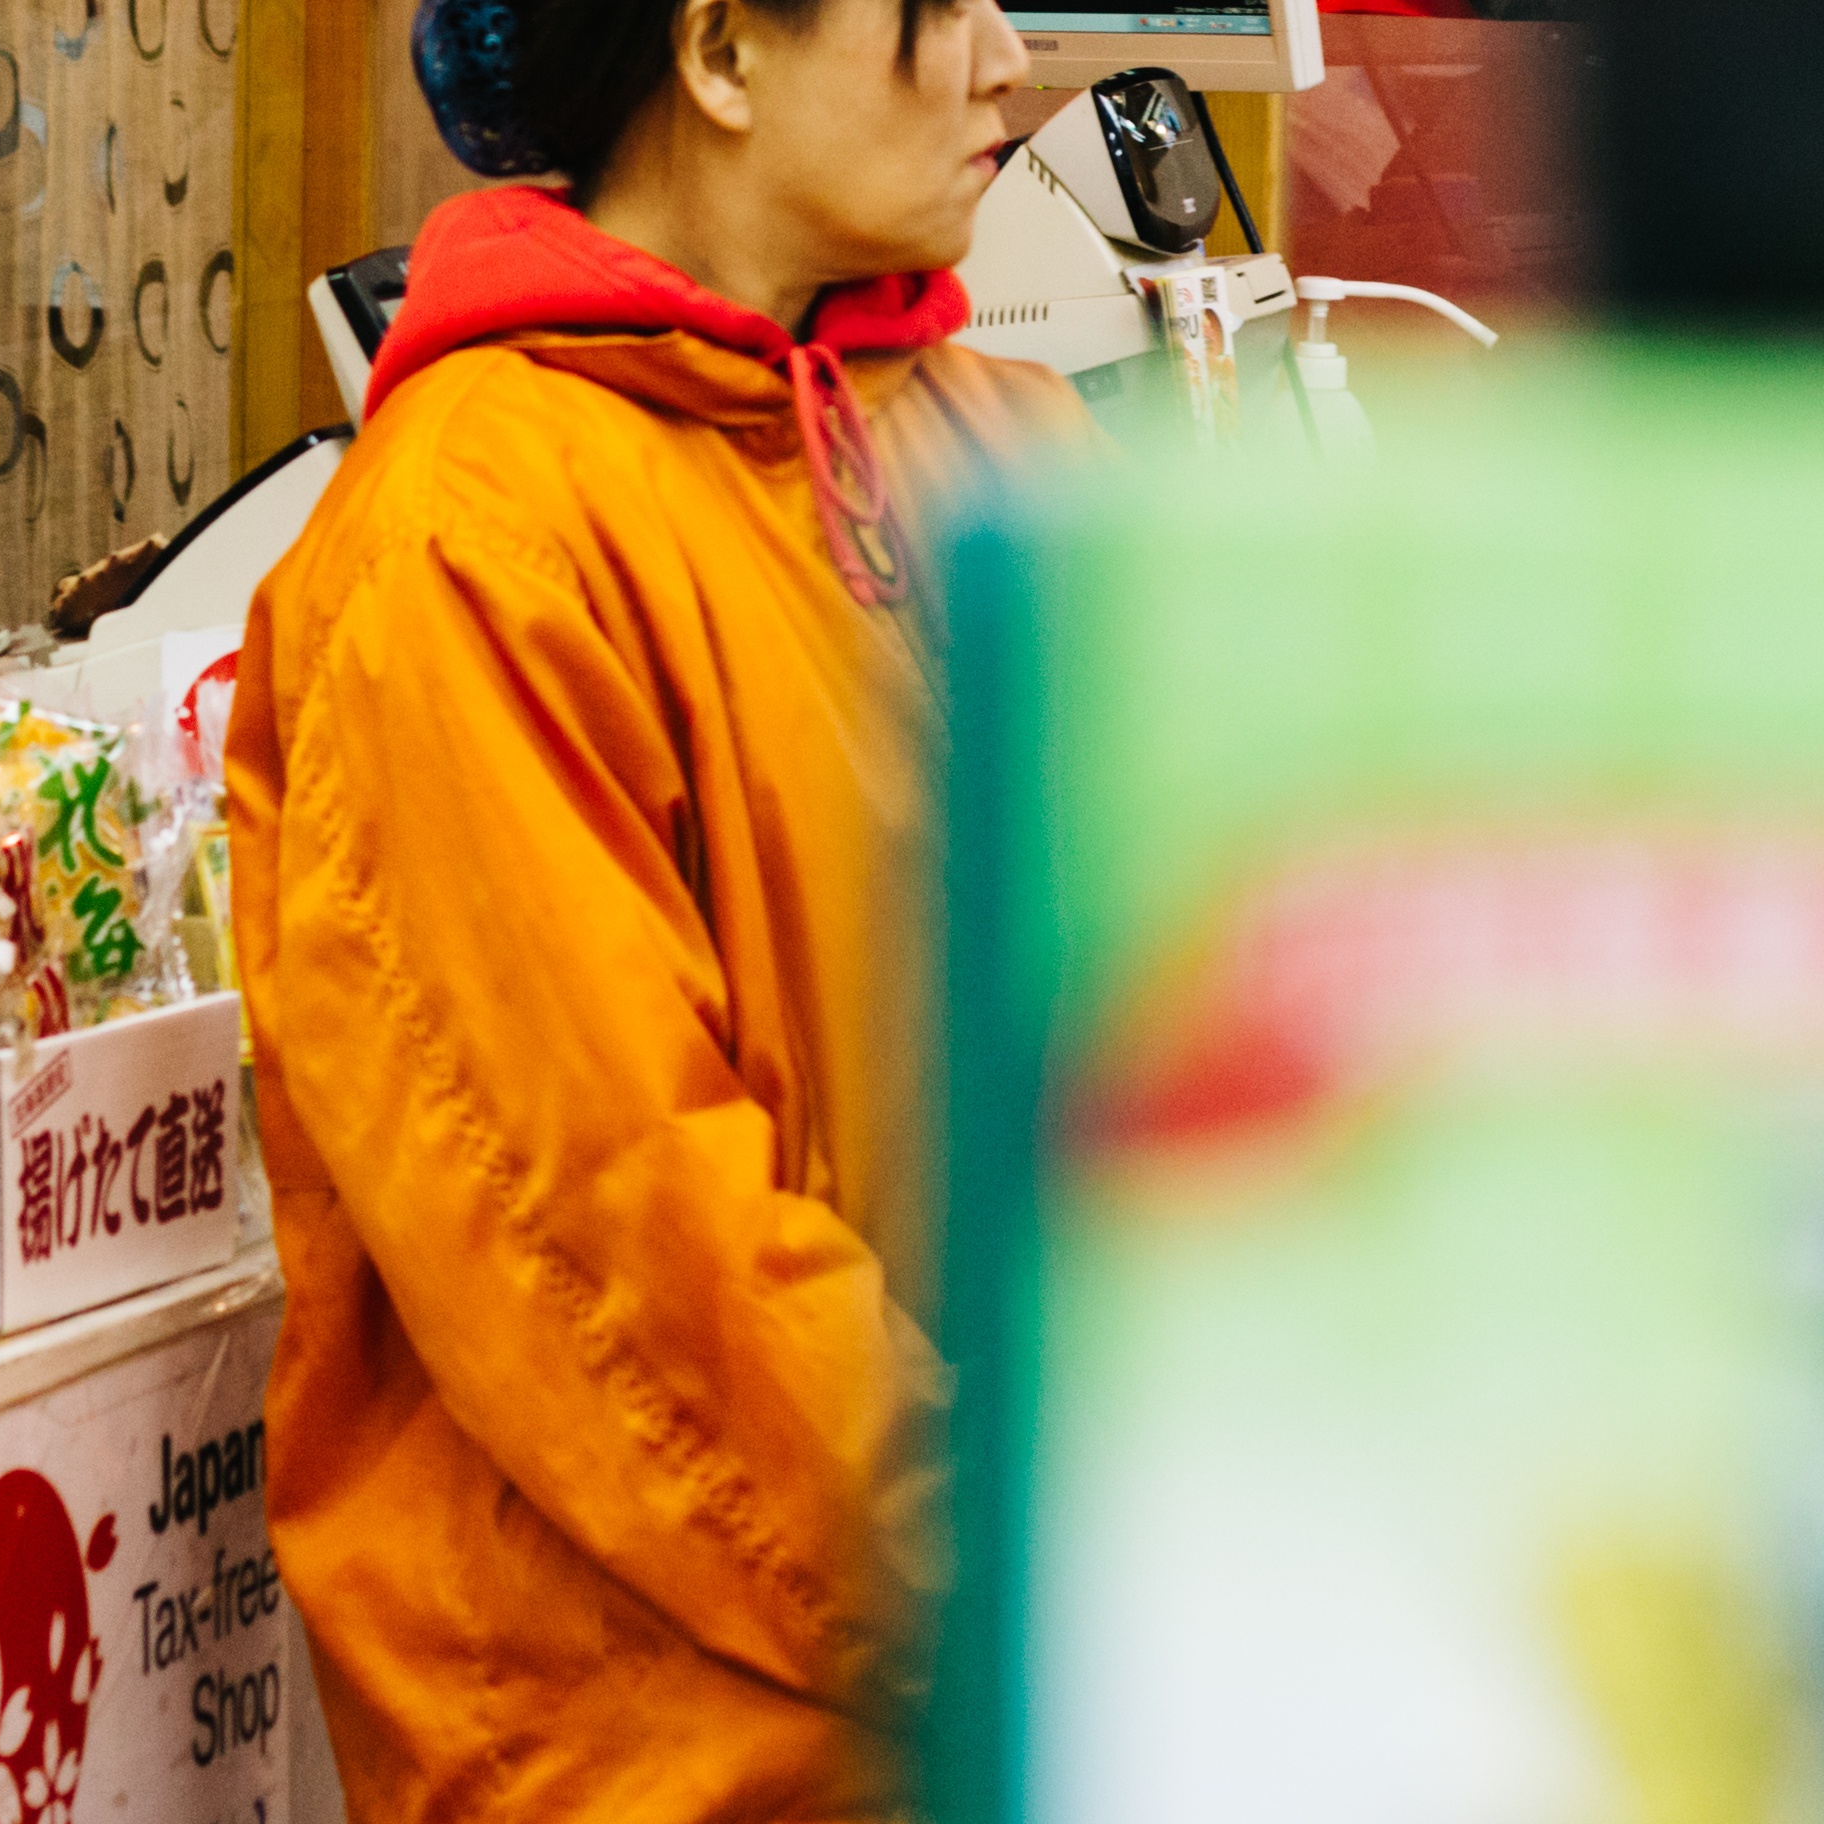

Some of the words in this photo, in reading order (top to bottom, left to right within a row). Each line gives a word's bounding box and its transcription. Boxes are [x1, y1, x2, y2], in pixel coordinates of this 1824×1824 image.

[149, 1418, 264, 1536] Japan
[132, 1547, 282, 1677] Tax-free
[191, 1661, 281, 1770] Shop
